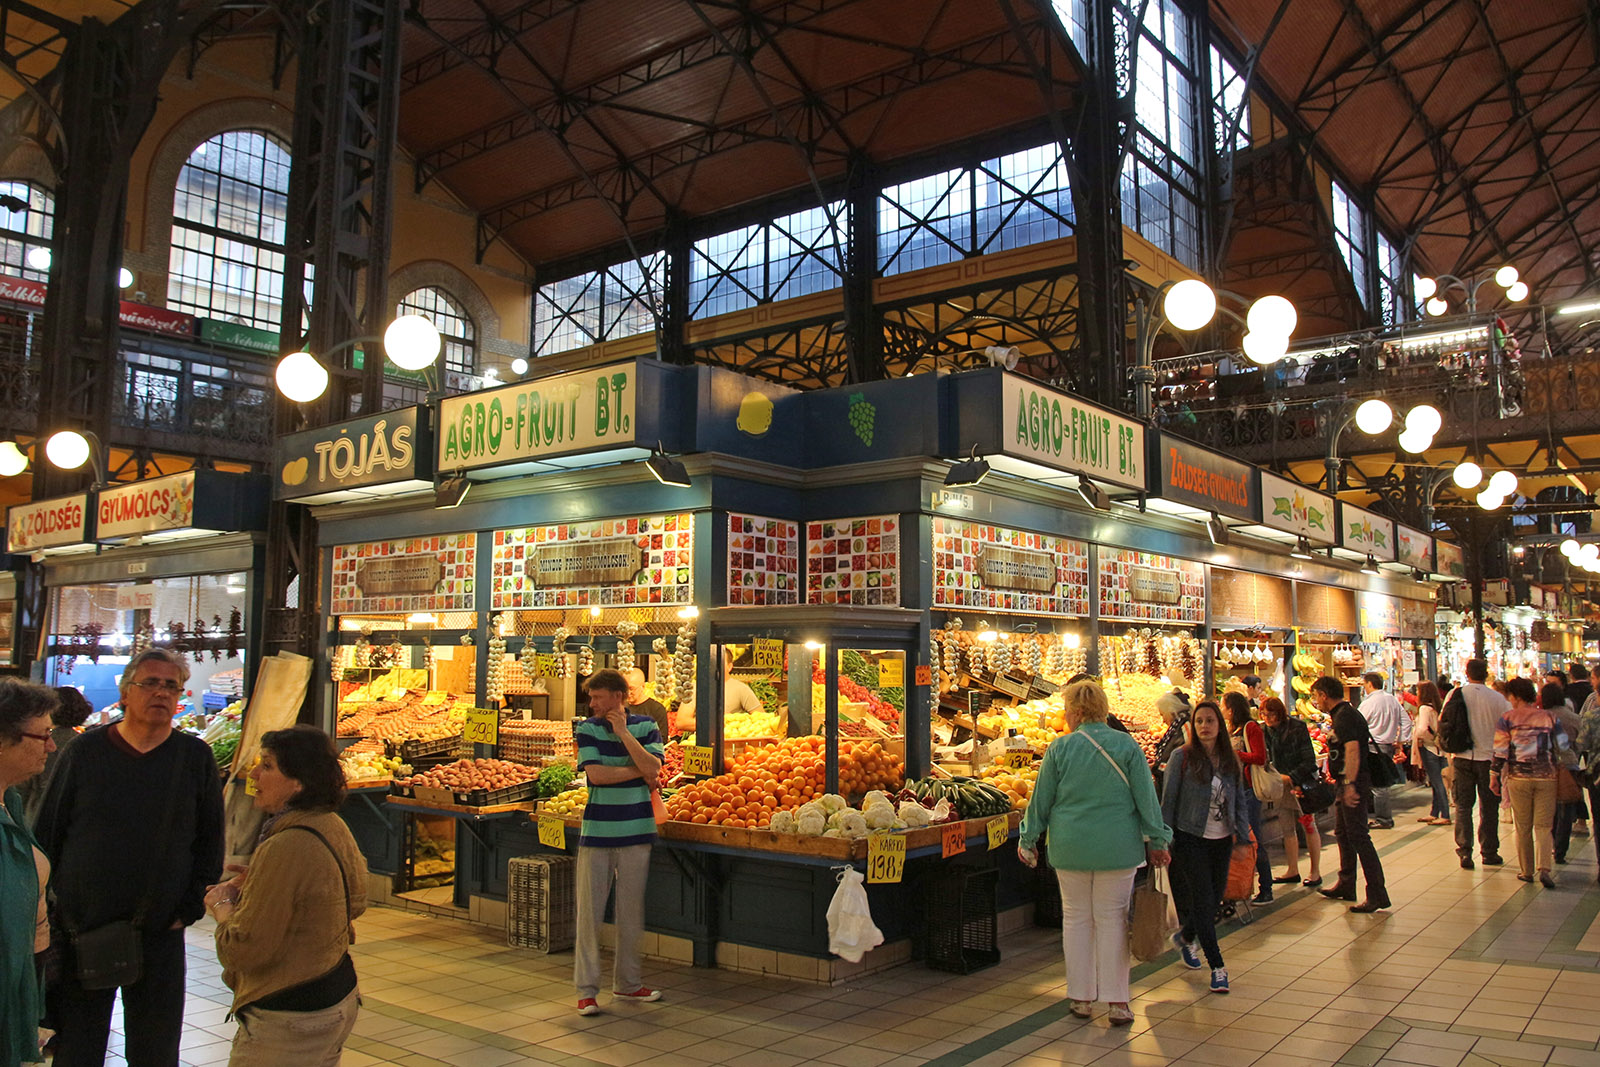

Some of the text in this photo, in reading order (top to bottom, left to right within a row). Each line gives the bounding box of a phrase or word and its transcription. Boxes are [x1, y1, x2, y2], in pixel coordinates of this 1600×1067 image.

[595, 372, 630, 437] BT.
[1016, 387, 1136, 479] AGRO-FRUIT BT.
[27, 501, 81, 536] ZÖLDSÉG
[469, 721, 494, 743] 398
[870, 854, 897, 880] 198
